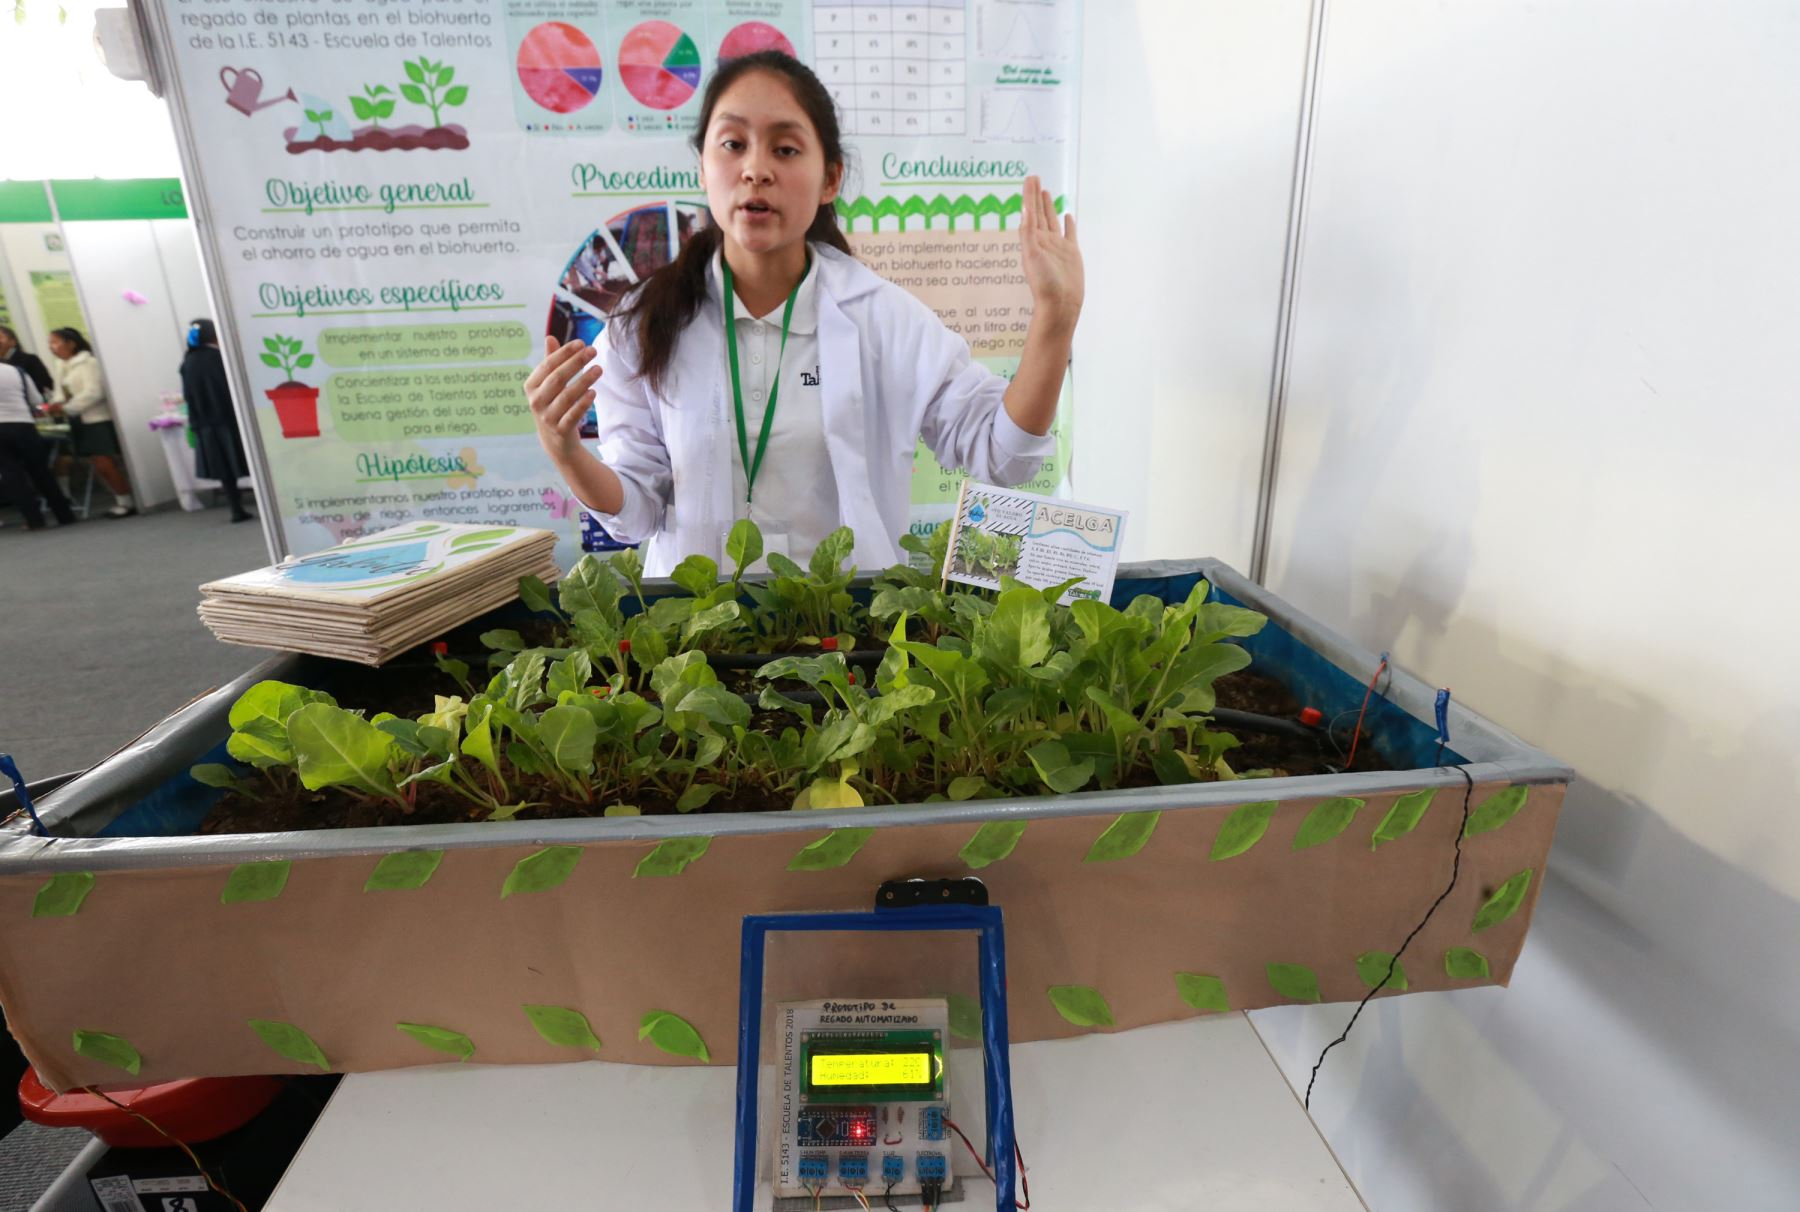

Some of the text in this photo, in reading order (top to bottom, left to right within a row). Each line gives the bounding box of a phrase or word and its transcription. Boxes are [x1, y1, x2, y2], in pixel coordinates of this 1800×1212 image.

[180, 11, 247, 30] regado
[254, 10, 278, 25] de
[286, 10, 351, 29] plantas
[357, 12, 379, 25] en
[386, 10, 402, 25] el
[408, 9, 492, 25] biohuerto
[189, 33, 213, 49] de
[218, 33, 235, 48] la
[267, 32, 309, 48] 5143
[324, 31, 389, 48] Escuela
[394, 32, 417, 47] de
[422, 31, 492, 47] Talentos
[882, 152, 1028, 180] Conclusiones
[572, 163, 700, 191] Procedimi
[266, 177, 475, 216] Objetivo general
[233, 220, 520, 241] Construir un prototipo que permita
[242, 240, 520, 260] el ahorro de agua en el biohuerto.
[861, 242, 895, 256] logró
[899, 242, 979, 255] implementar
[983, 243, 999, 252] un
[1002, 242, 1022, 254] pro
[872, 257, 1018, 271] un biohuerto haciendo
[888, 276, 922, 287] tema
[926, 277, 948, 286] sea
[259, 278, 504, 318] Objetivos específicos
[965, 306, 976, 317] al
[985, 307, 1010, 316] usar
[1018, 307, 1034, 316] nu
[324, 326, 524, 346] Implementar nuestro prototipo
[965, 324, 980, 333] un
[984, 322, 1006, 332] litro
[1010, 321, 1027, 331] de
[359, 350, 375, 360] en
[379, 349, 393, 360] un
[396, 346, 440, 359] sistema
[443, 345, 460, 357] de
[972, 337, 1024, 350] riego no
[334, 369, 530, 389] Concientizar a los estudiantes de
[800, 372, 819, 386] Tal
[337, 394, 350, 405] la
[356, 391, 402, 405] Escuela
[408, 390, 423, 401] de
[430, 389, 477, 400] Talentos
[483, 387, 516, 399] sobre
[341, 411, 381, 421] buena
[386, 406, 429, 422] gestión
[433, 406, 451, 417] del
[456, 406, 475, 416] uso
[480, 403, 498, 415] del
[403, 425, 432, 436] para
[434, 422, 445, 432] el
[356, 452, 467, 482] Hipótesis
[939, 479, 951, 492] el
[307, 494, 409, 509] implementamos
[412, 490, 456, 502] nuestro
[460, 486, 514, 501] prototipo
[518, 487, 534, 496] en
[537, 486, 554, 496] un
[298, 513, 345, 524] sistema
[353, 510, 371, 521] de
[422, 504, 479, 516] entonces
[487, 502, 556, 515] lograremos
[1035, 507, 1113, 534] ACELGA
[820, 1014, 918, 1024] REGADO AUTOMATIZADO
[785, 1031, 793, 1077] TALENTOS
[784, 1080, 791, 1092] DE
[783, 1094, 792, 1134] ESCUELA
[782, 1143, 790, 1166] 5143
